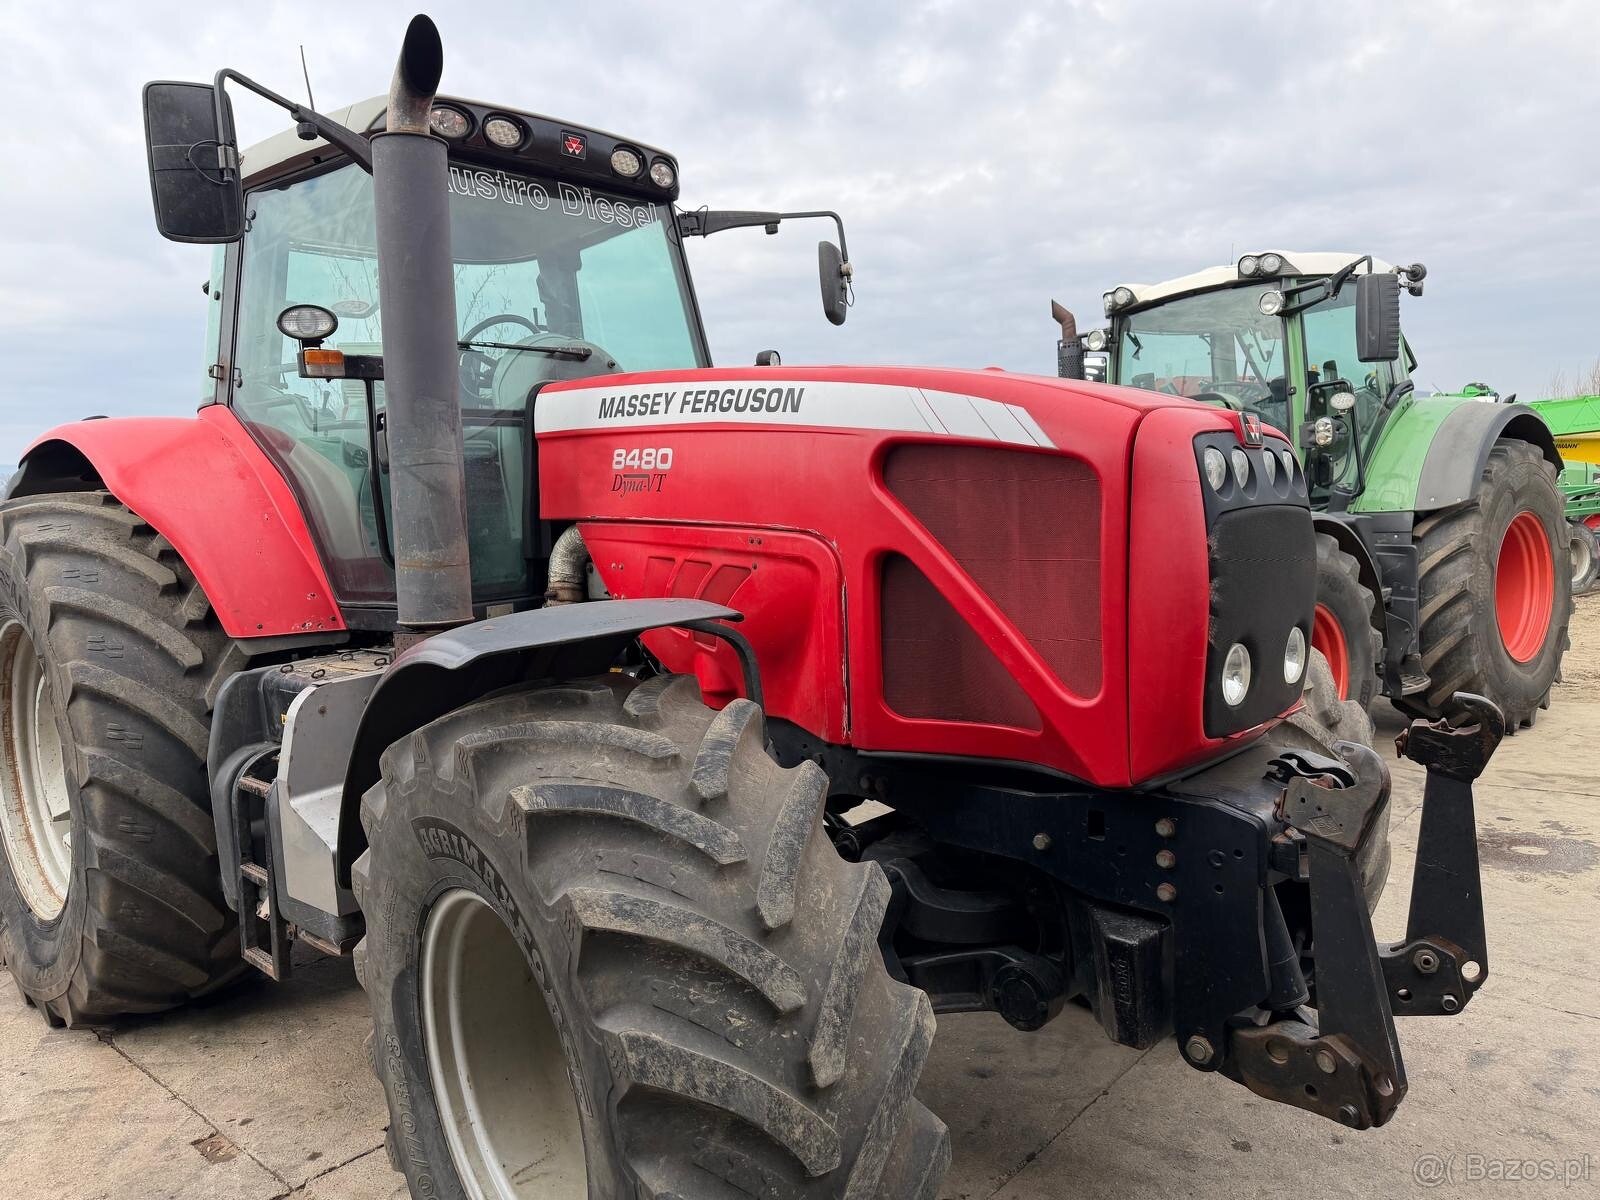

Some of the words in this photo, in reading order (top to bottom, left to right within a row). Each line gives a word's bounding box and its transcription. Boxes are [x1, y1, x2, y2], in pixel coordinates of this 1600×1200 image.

[448, 165, 551, 212] ustro
[556, 180, 659, 229] Diesel
[598, 391, 677, 419] MASSEY
[680, 387, 805, 414] FERGUSON
[612, 447, 674, 470] 8480
[611, 474, 667, 497] Dyna-VT
[419, 827, 518, 928] AGRIMAX
